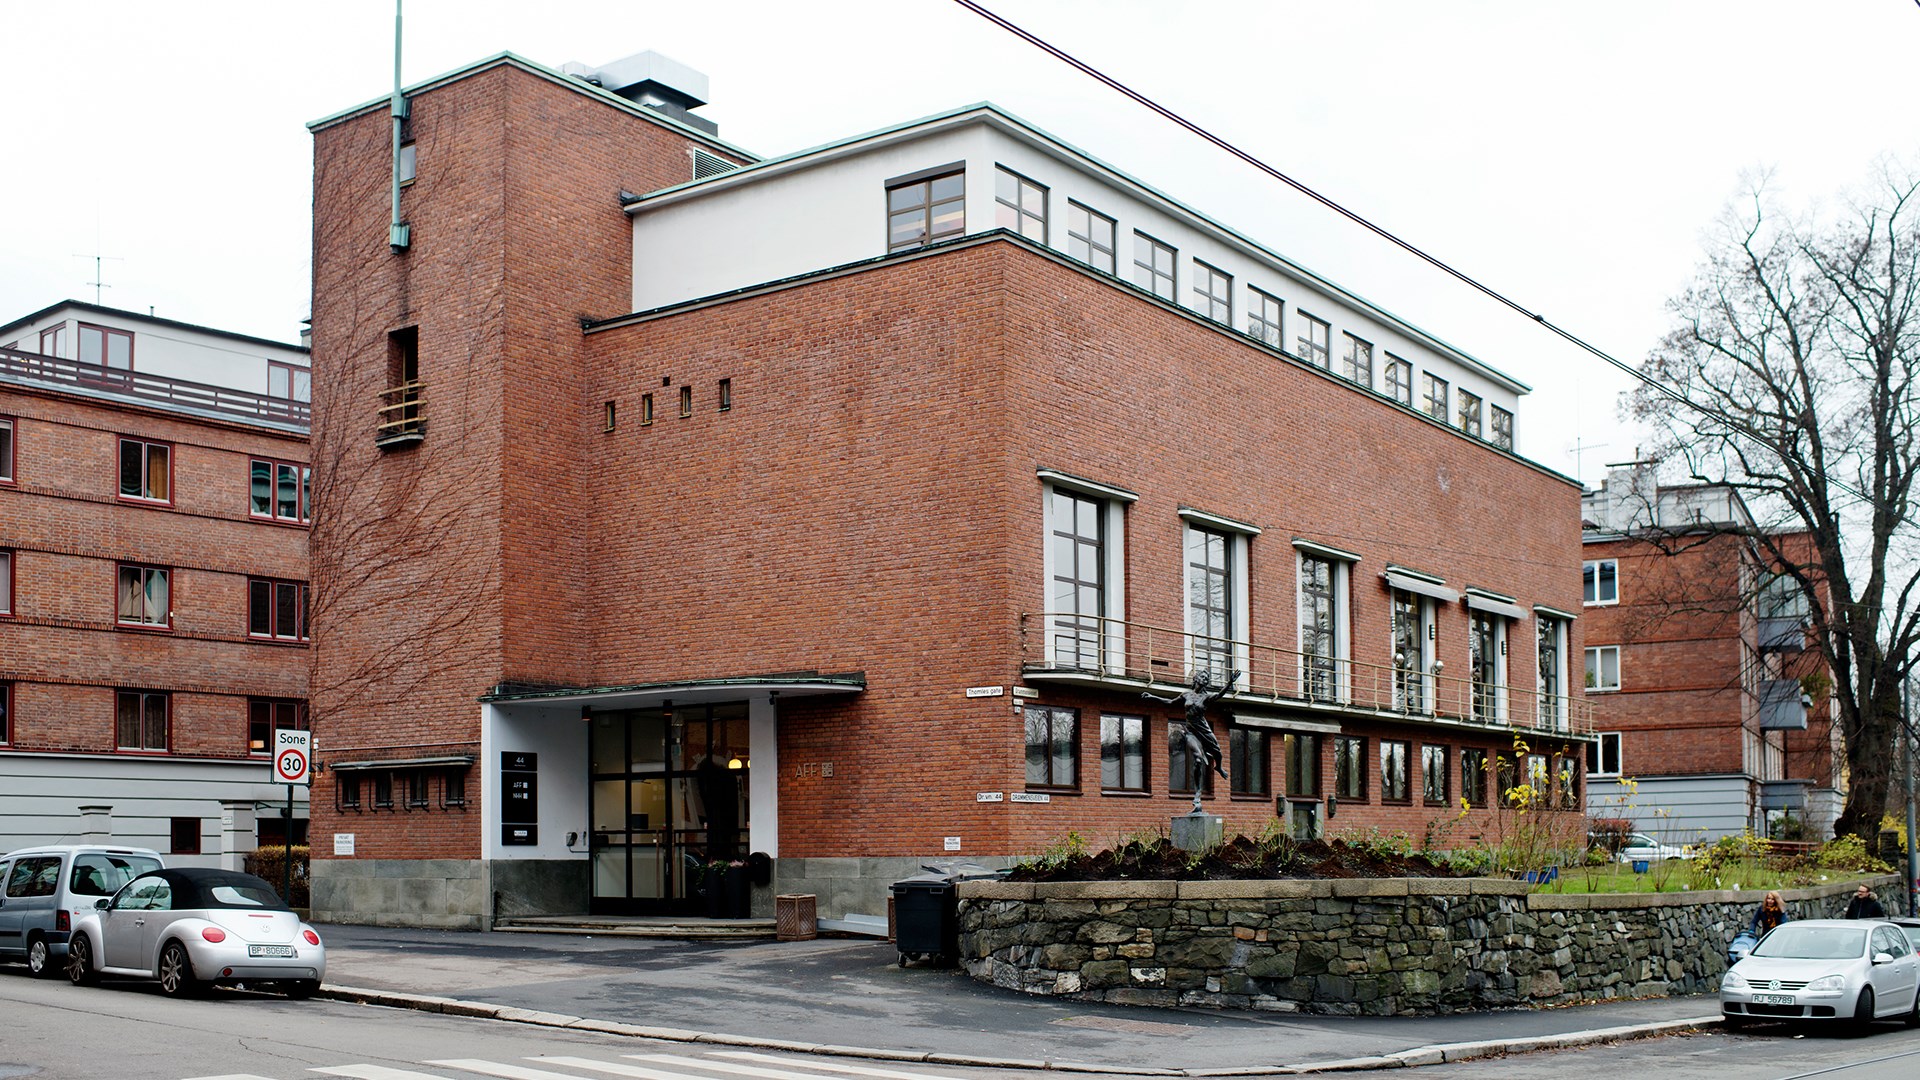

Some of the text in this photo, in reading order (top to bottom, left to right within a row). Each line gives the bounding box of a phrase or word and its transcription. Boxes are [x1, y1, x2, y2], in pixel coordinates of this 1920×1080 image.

[280, 733, 306, 745] Sone
[283, 757, 301, 771] 30
[795, 762, 817, 778] AFF
[251, 946, 261, 954] BP
[1754, 995, 1793, 1004] RJ 56789
